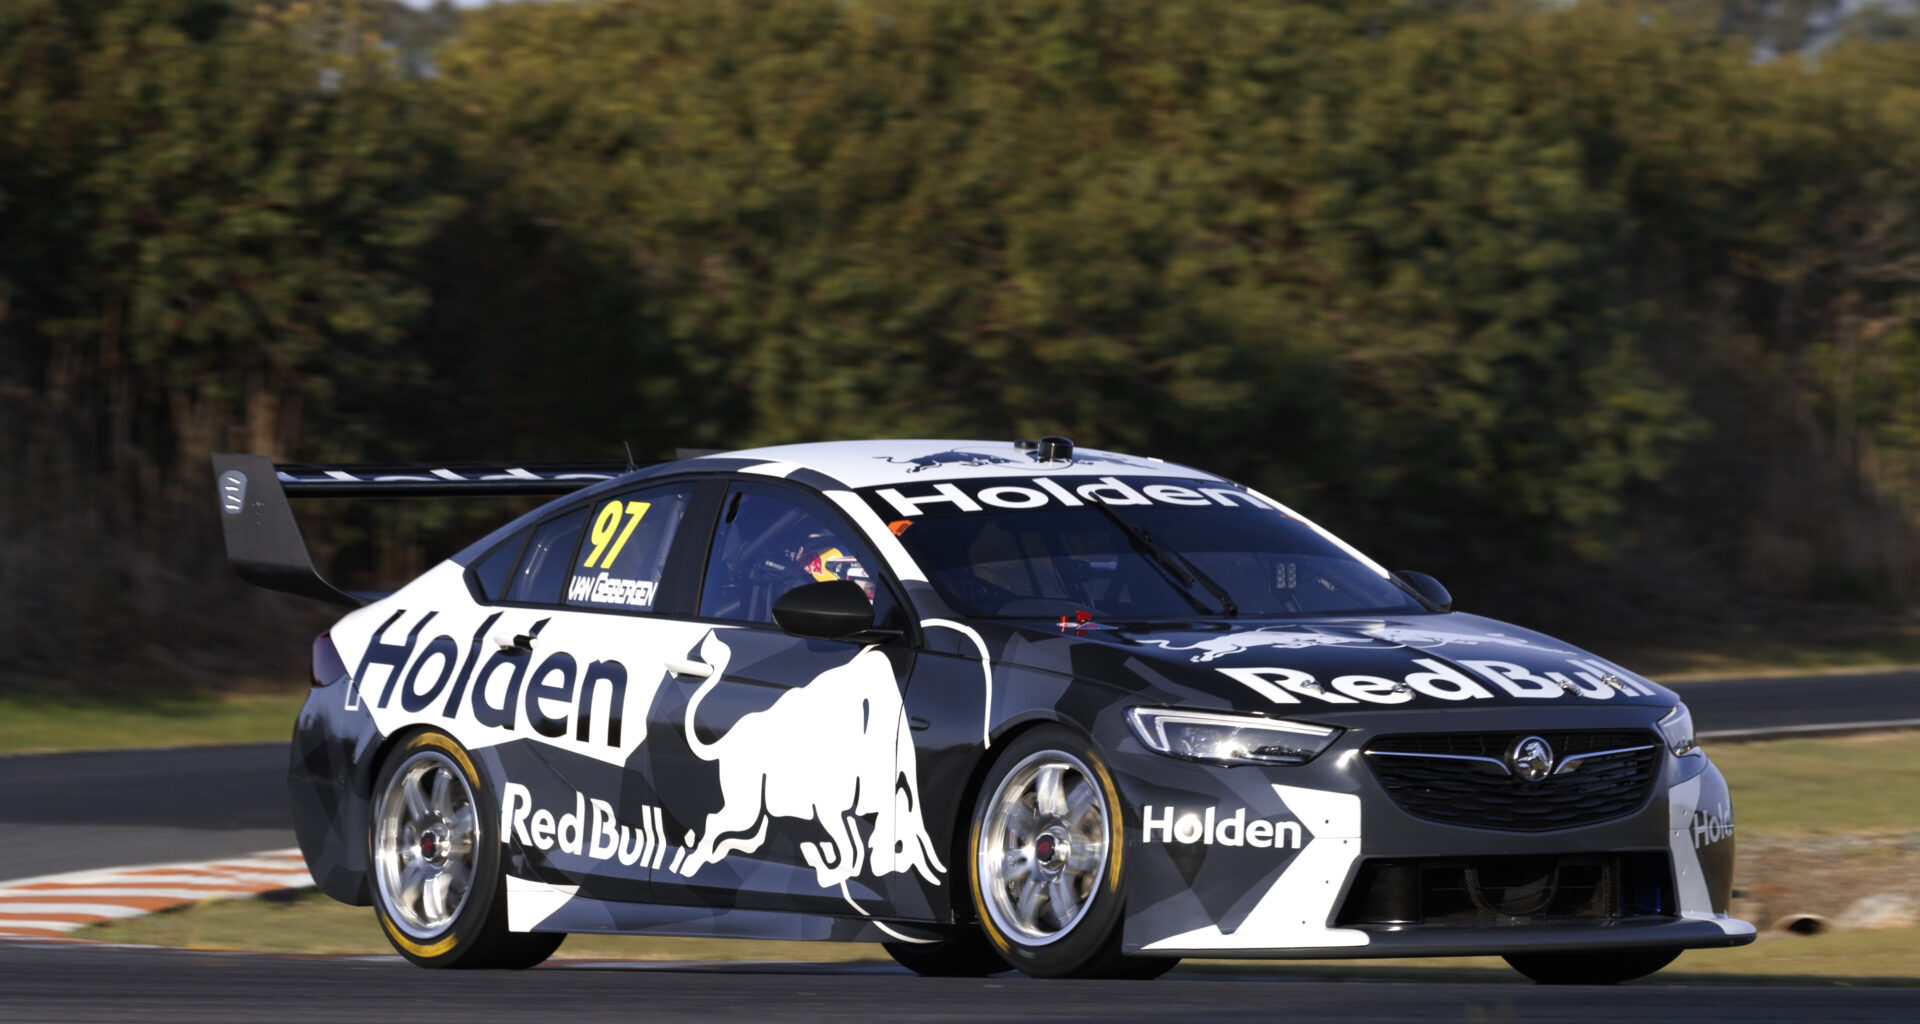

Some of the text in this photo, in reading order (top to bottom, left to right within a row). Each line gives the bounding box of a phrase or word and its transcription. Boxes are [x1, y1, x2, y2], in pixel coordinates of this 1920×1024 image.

[876, 477, 1273, 517] Holden
[583, 500, 652, 569] 97
[568, 575, 595, 602] VAN
[345, 609, 628, 748] Holden
[1215, 659, 1655, 704] Red Bull
[501, 782, 664, 870] Red Bull
[1142, 804, 1301, 849] Holden
